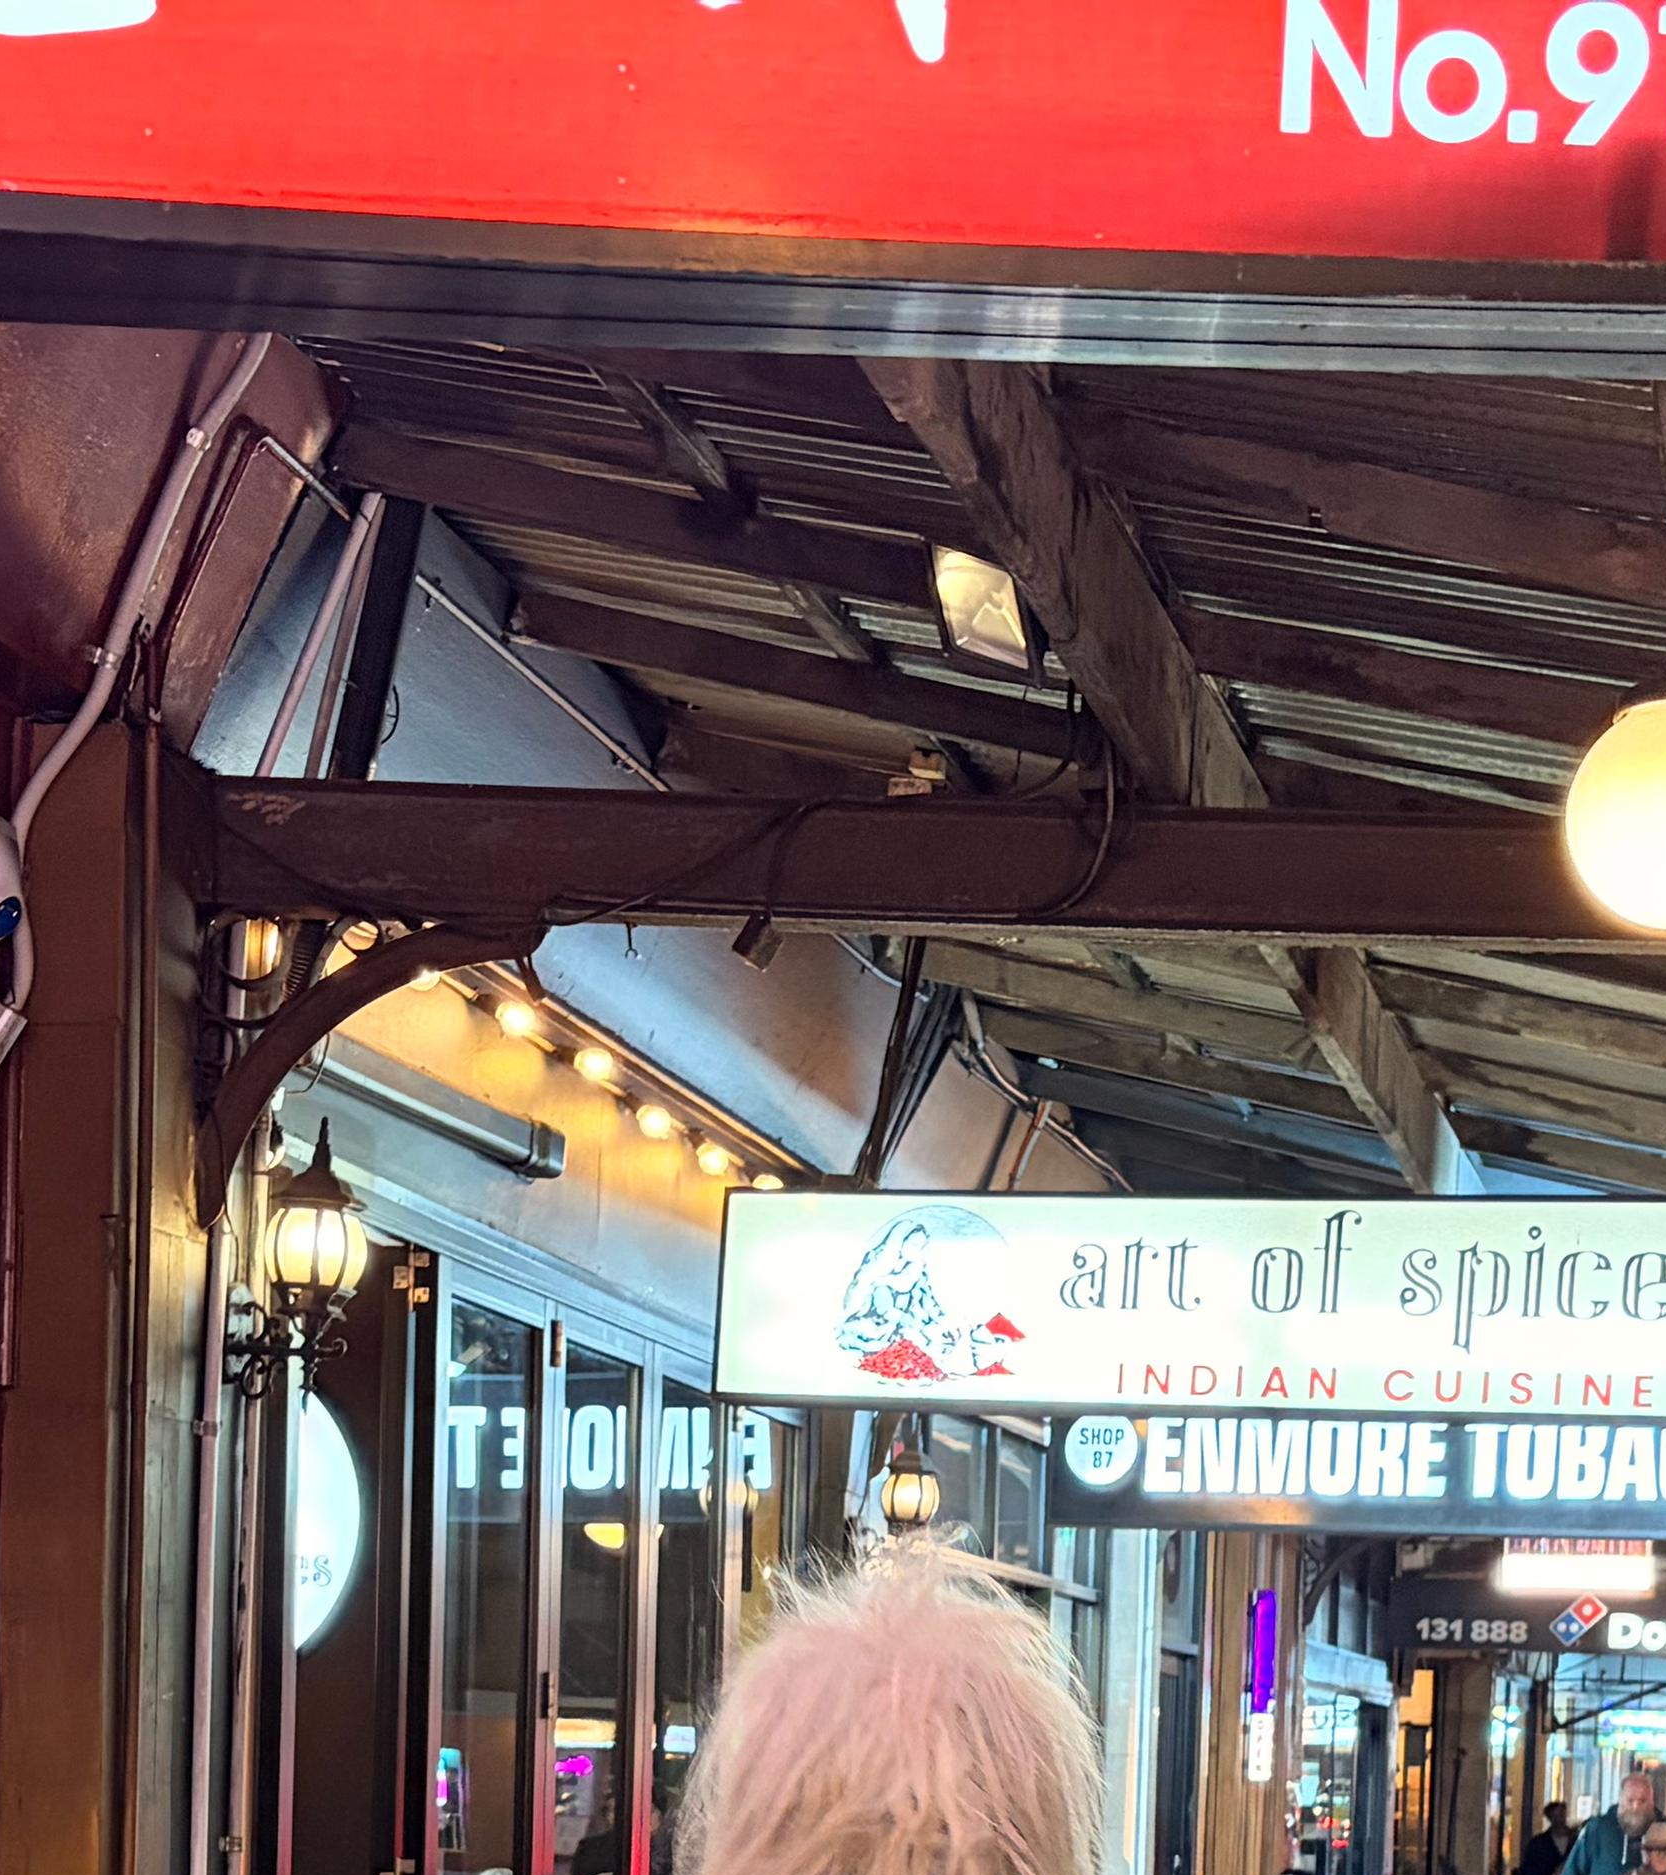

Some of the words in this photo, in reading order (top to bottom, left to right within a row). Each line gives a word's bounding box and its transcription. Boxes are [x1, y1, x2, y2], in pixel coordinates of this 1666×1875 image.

[1058, 1236, 1202, 1312] art
[1250, 1208, 1363, 1315] of
[1116, 1362, 1339, 1401] INDIAN
[1383, 1369, 1658, 1408] CUISINE
[1079, 1427, 1126, 1446] SHOP
[1091, 1450, 1114, 1470] 87
[1143, 1414, 1448, 1497] ENMORE
[1415, 1616, 1463, 1642] 131
[1469, 1618, 1528, 1644] 888
